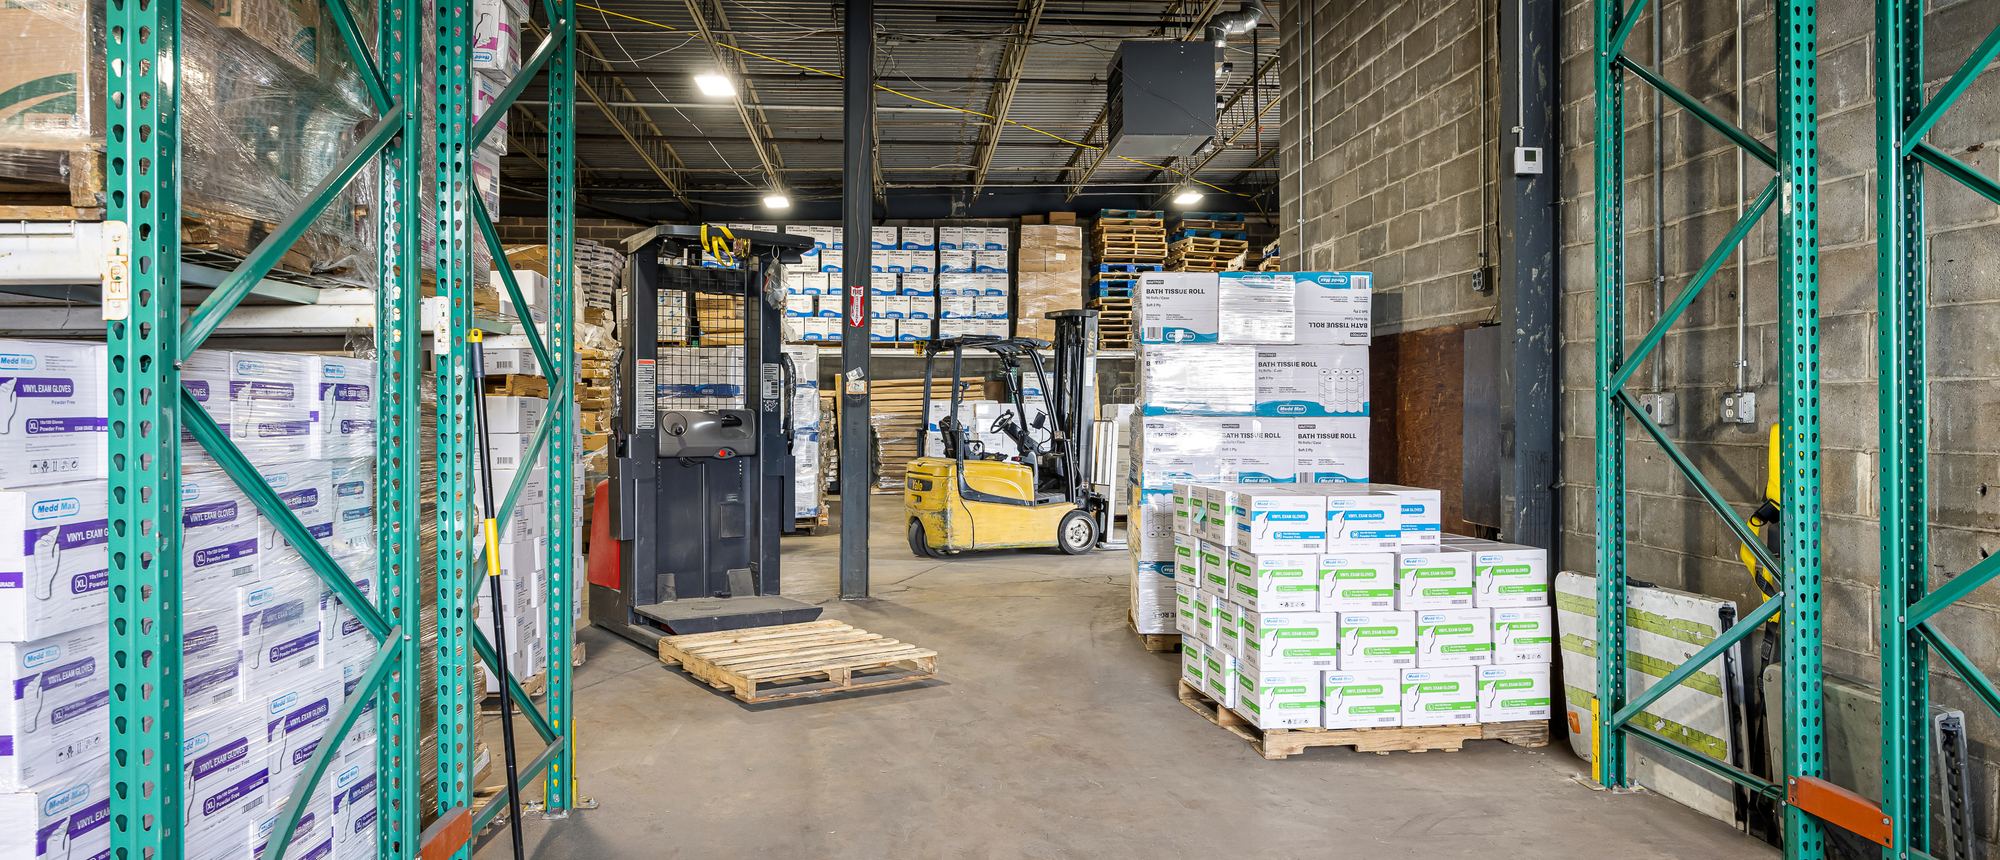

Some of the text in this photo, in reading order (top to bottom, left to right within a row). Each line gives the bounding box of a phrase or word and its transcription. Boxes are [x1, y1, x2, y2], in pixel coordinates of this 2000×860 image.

[23, 385, 37, 393] VINYL
[38, 504, 58, 512] Medd
[190, 513, 203, 522] VINYL
[218, 508, 234, 517] GLOVES
[67, 529, 103, 542] VINYL EXAM
[28, 652, 44, 662] Medd
[48, 664, 93, 684] VINYL EXAM GLOVES
[290, 717, 301, 726] VINYL
[312, 705, 326, 718] GLOVES
[200, 761, 213, 773] VINYL
[214, 755, 227, 766] EXAM
[77, 815, 94, 829] VINYL
